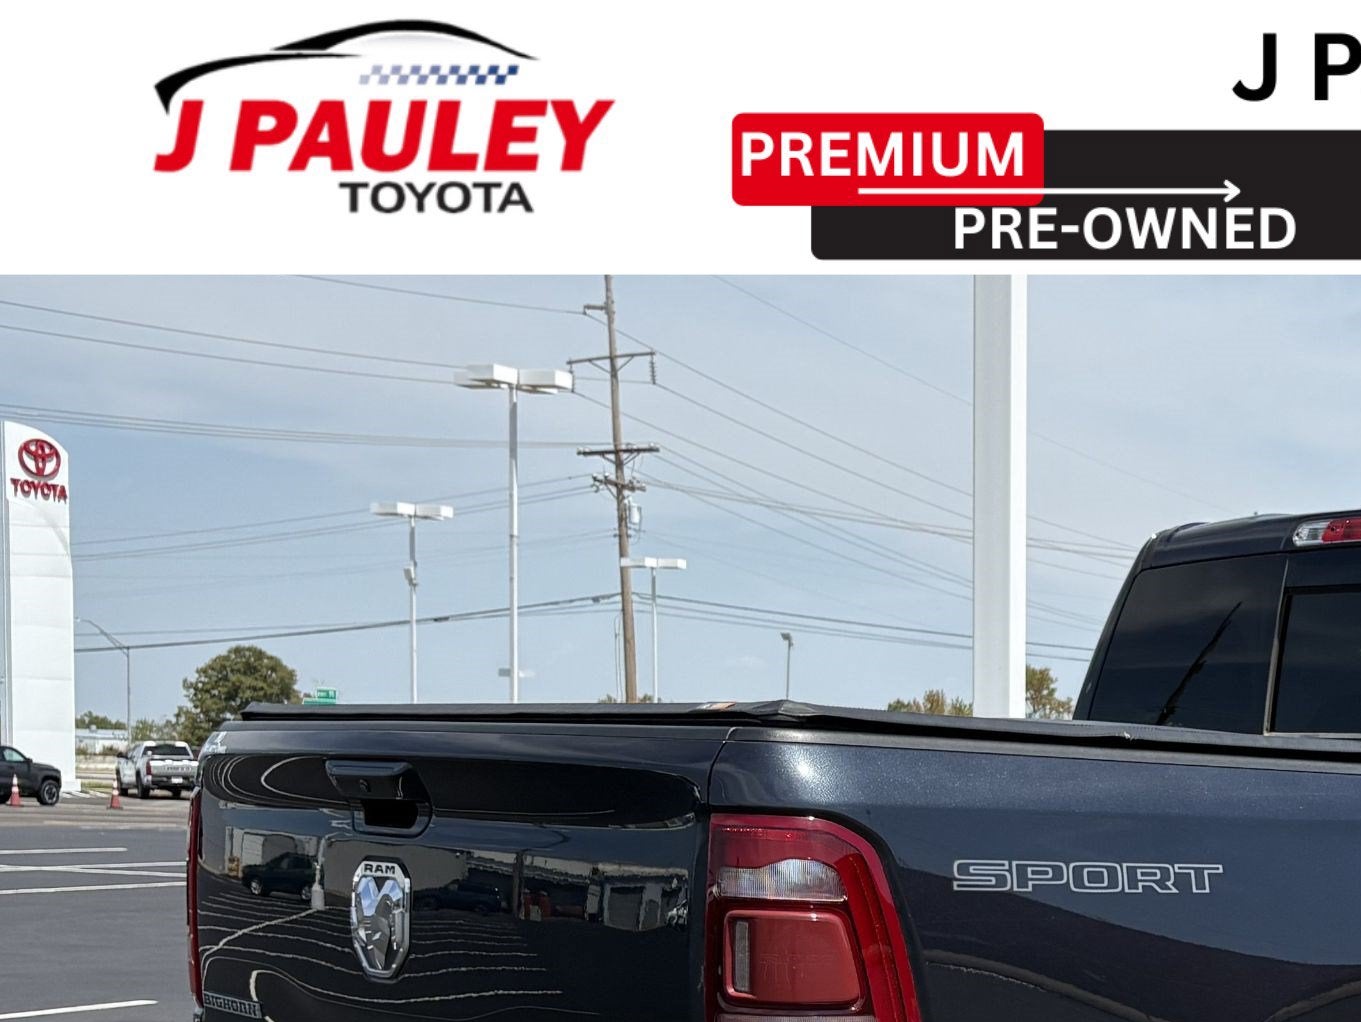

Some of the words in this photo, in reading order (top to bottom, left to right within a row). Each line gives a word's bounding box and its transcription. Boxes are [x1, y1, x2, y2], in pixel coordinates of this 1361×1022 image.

[10, 478, 68, 504] TOYOTA
[363, 863, 396, 875] RAM
[953, 860, 1223, 893] SPORT
